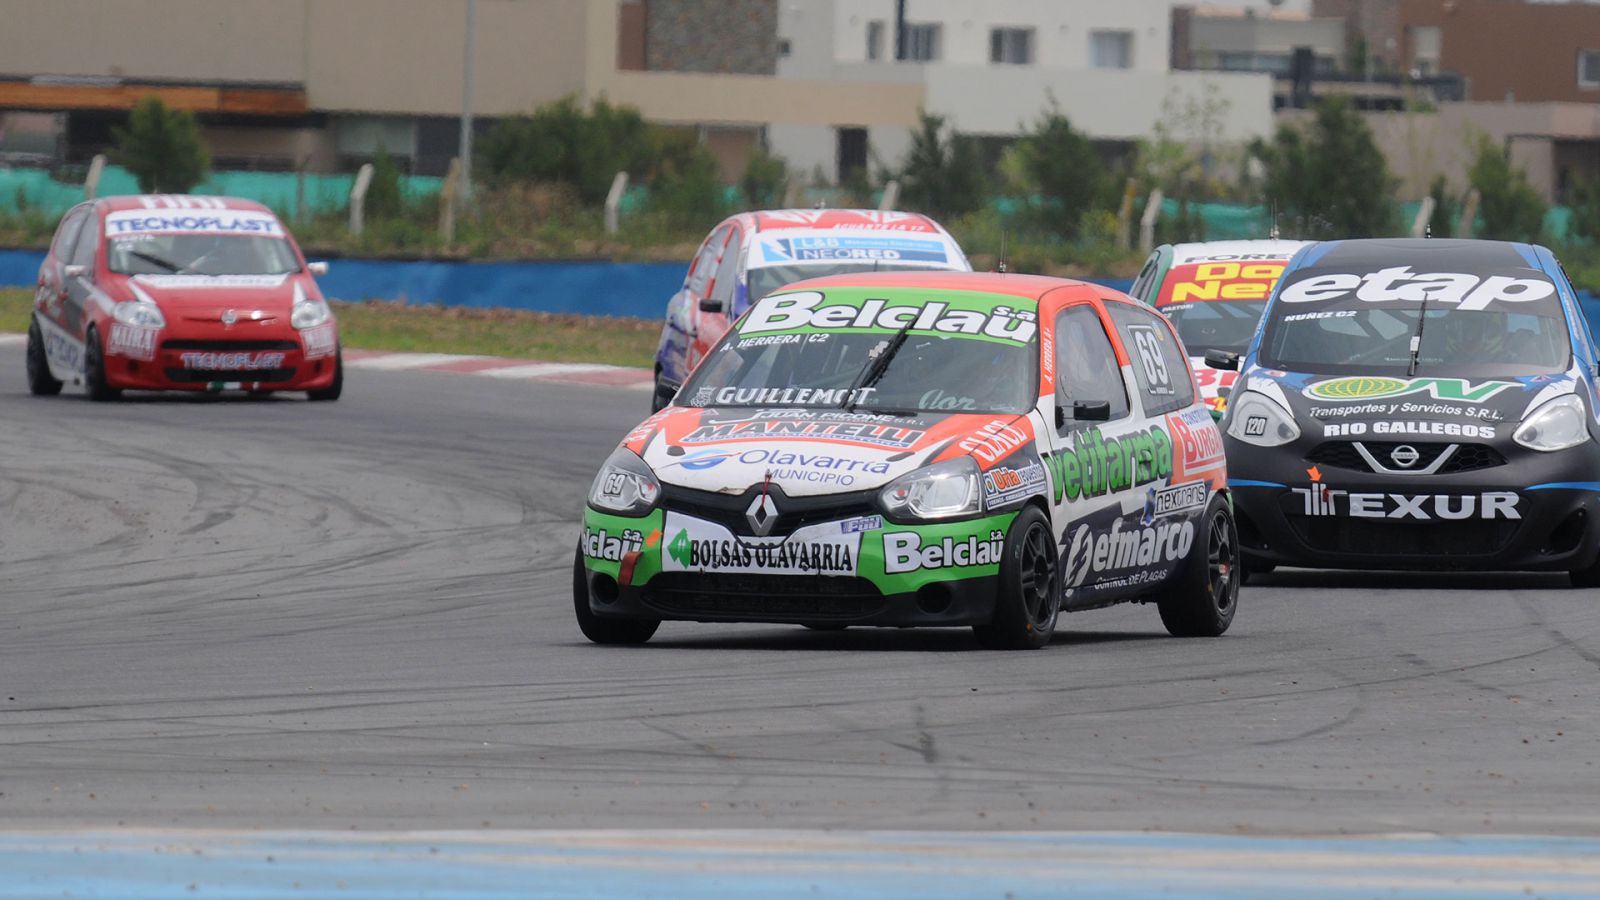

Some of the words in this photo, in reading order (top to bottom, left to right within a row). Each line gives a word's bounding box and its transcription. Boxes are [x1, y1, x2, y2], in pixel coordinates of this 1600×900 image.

[111, 217, 276, 232] TECNOPLAST
[803, 248, 900, 259] NEORED
[1279, 266, 1555, 311] etap
[720, 343, 734, 352] A.
[737, 334, 801, 347] HERRERA
[808, 333, 830, 342] C2
[180, 352, 286, 370] TECNOPLAST
[1135, 331, 1168, 385] 69
[716, 386, 876, 404] GUILLEMOT
[821, 412, 895, 423] PICONE
[1310, 403, 1386, 417] Transportes
[1390, 405, 1400, 415] y
[1401, 402, 1461, 415] Servicios
[684, 421, 924, 445] MANTELLI
[1246, 419, 1265, 435] 120
[1324, 423, 1367, 437] RIO
[1373, 422, 1496, 439] GALLEGOS
[605, 473, 627, 495] 69
[767, 469, 855, 486] MUNICIPIO
[1155, 483, 1205, 512] nextrans
[1093, 517, 1194, 572] efmarco
[690, 540, 751, 568] BOLSAS
[754, 542, 852, 571] OLAVARRIA
[1139, 569, 1167, 585] PLAGAS
